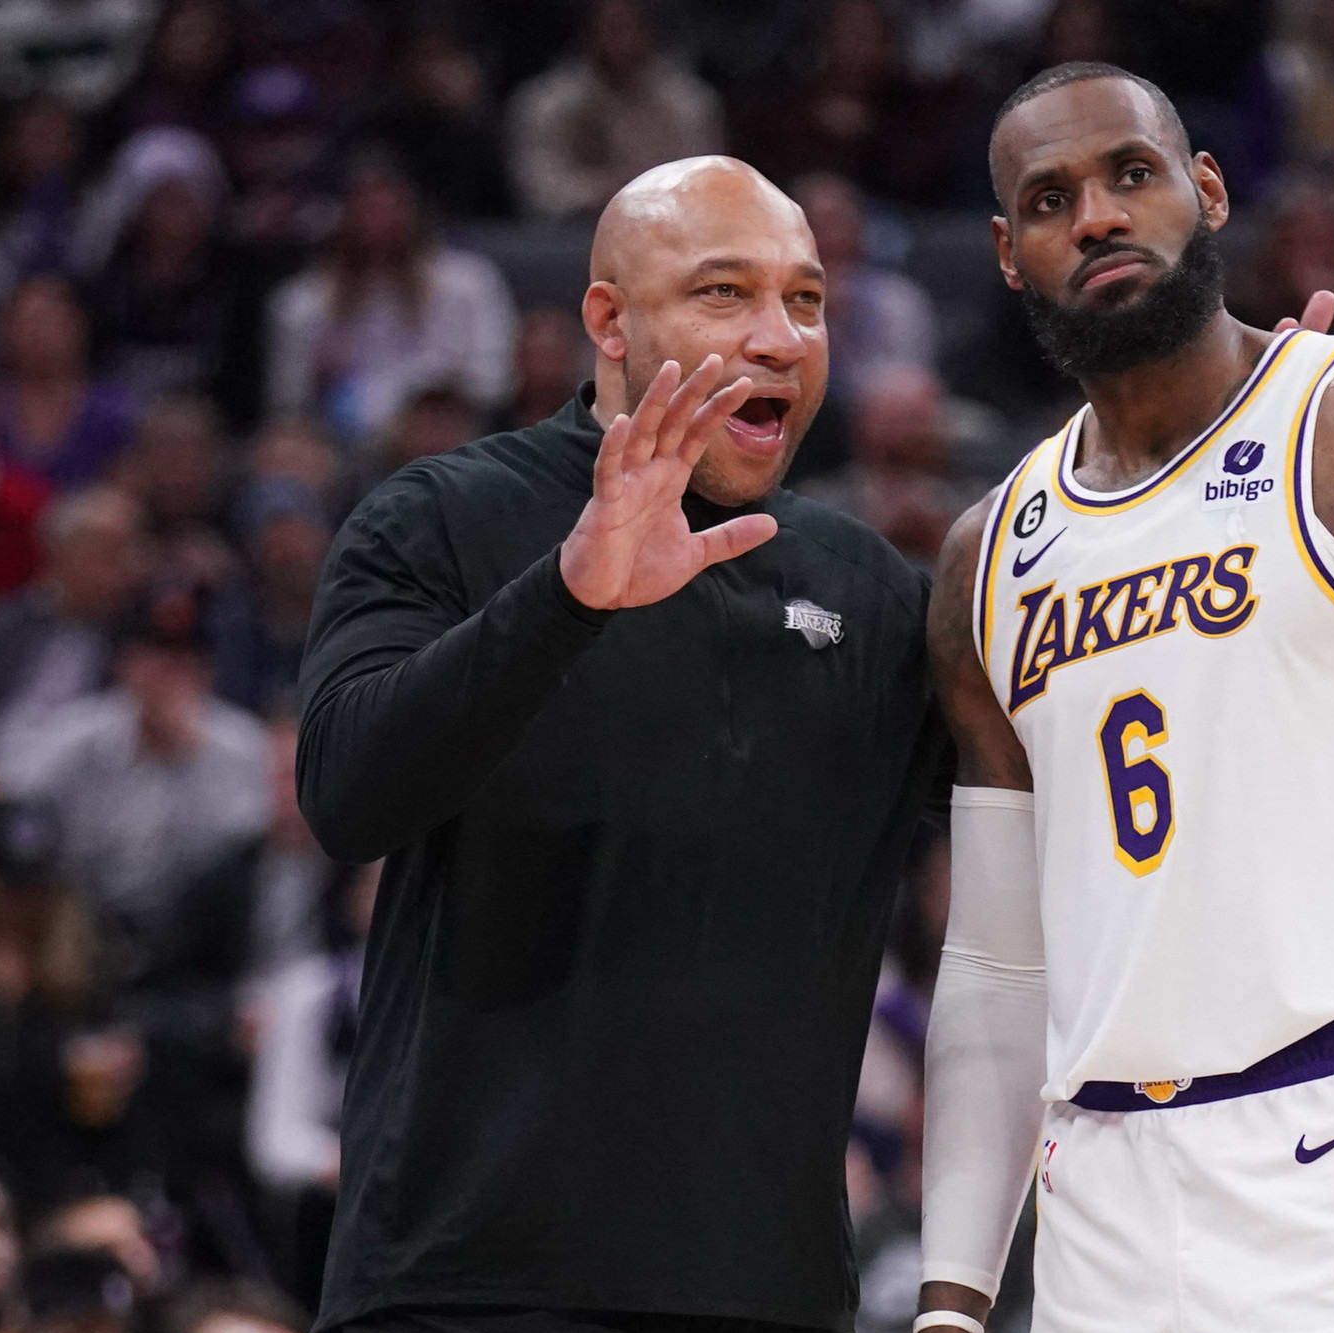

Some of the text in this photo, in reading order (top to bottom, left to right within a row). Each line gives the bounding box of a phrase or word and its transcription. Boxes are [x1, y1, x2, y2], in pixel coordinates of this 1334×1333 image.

[1204, 477, 1274, 502] bibigo
[1020, 496, 1043, 535] 6
[783, 606, 844, 644] LAKERS
[1008, 543, 1261, 719] LAKERS
[1095, 687, 1176, 878] 6
